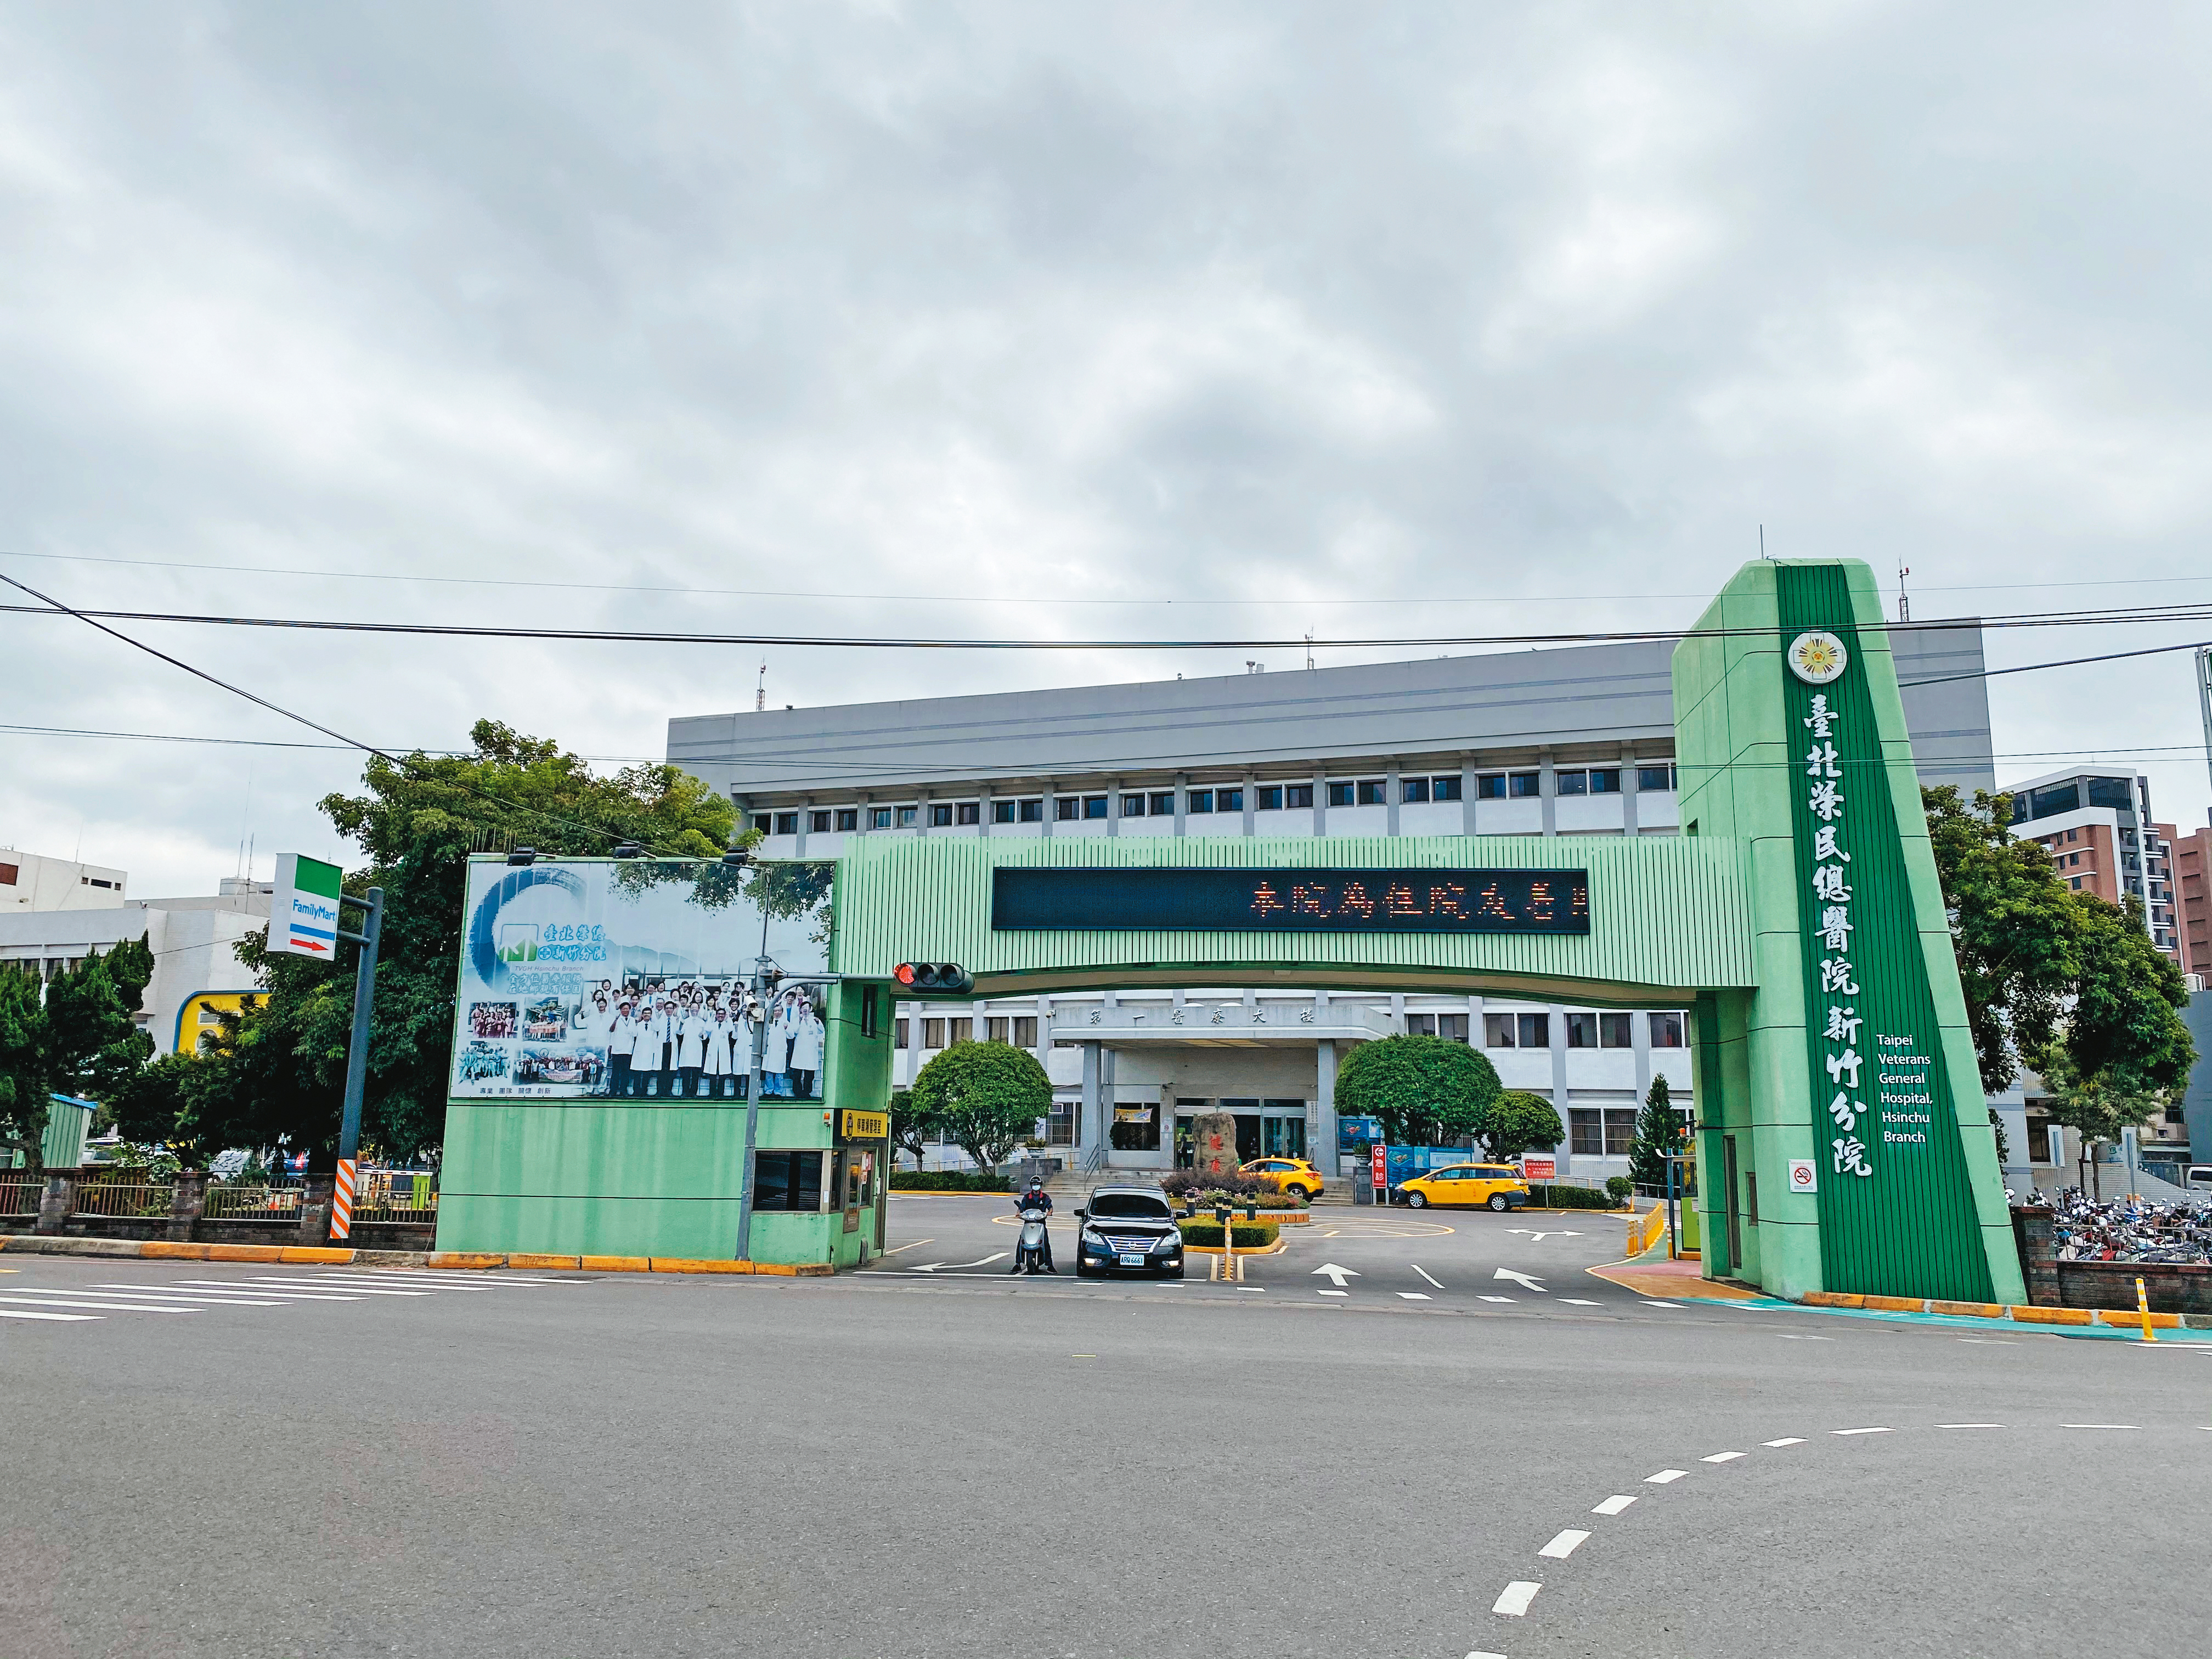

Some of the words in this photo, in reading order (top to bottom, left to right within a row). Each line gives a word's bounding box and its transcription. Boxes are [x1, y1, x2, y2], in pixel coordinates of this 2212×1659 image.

[293, 899, 336, 921] FamilyMart
[544, 923, 606, 941] 臺北榮總
[1804, 693, 1872, 1177] 臺北榮民總醫院新竹分院
[552, 944, 606, 961] 新竹分院
[1090, 1008, 1314, 1024] 第一醫療大樓
[1876, 1034, 1913, 1047] Taipei
[1878, 1053, 1931, 1065] Veterans
[1879, 1073, 1925, 1084] General
[1881, 1092, 1933, 1105] Hospital,
[1882, 1111, 1930, 1123] Hsinchu
[1883, 1131, 1926, 1143] Branch
[1374, 1158, 1384, 1181] 急診
